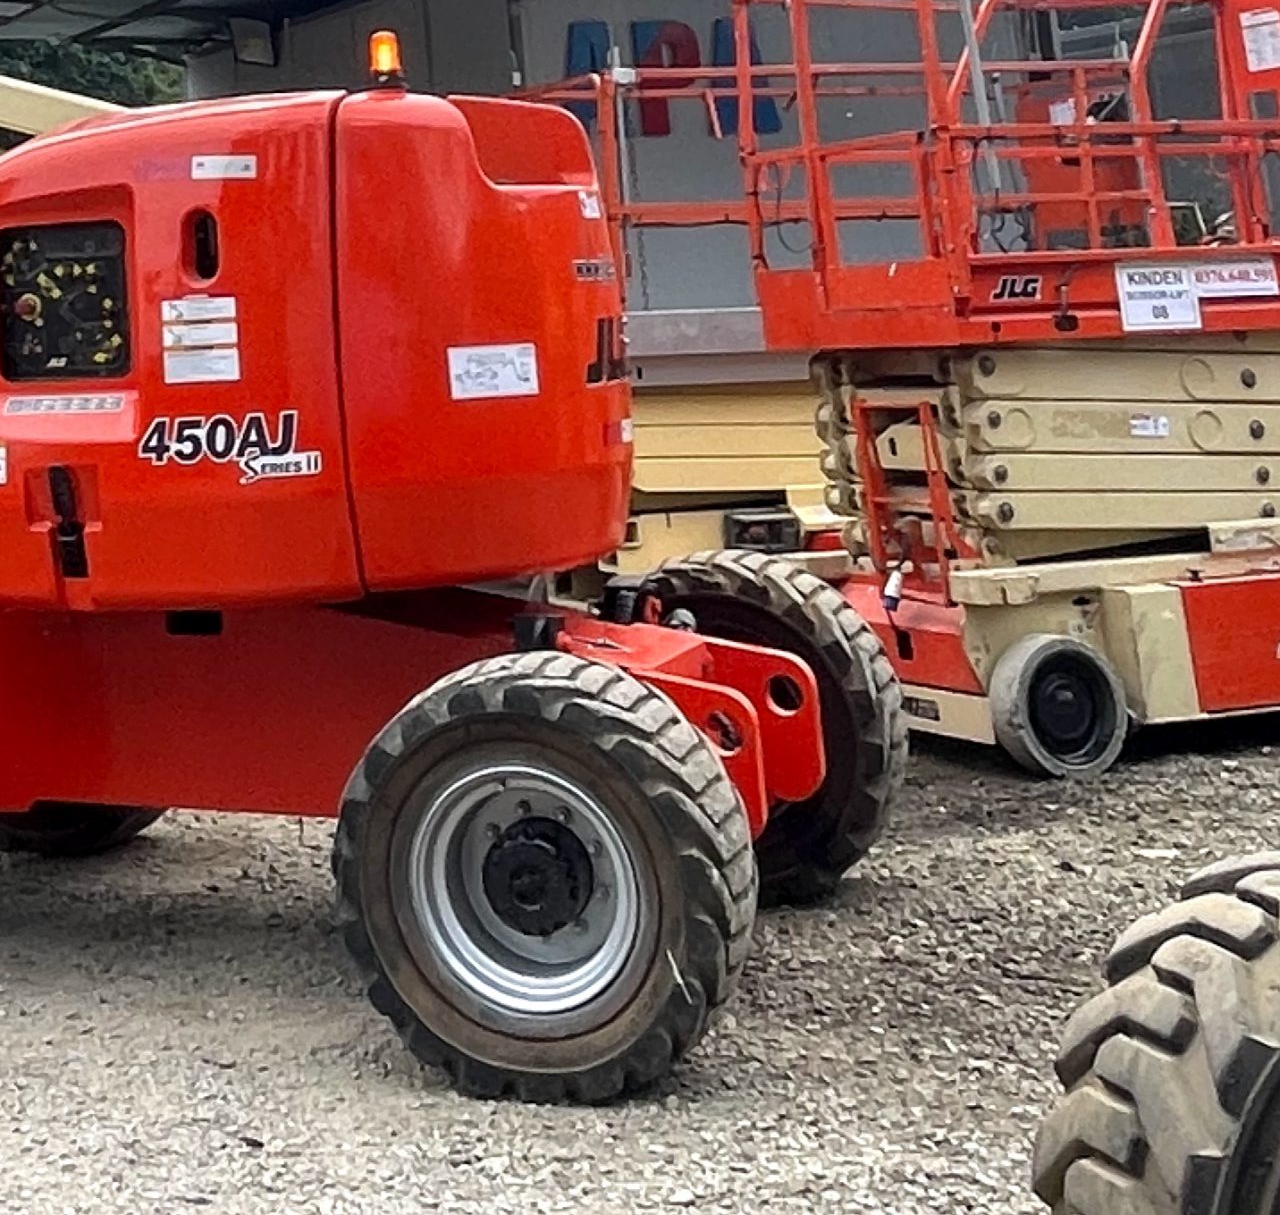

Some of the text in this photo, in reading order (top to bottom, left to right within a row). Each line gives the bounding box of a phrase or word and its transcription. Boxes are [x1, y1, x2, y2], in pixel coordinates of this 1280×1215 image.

[992, 277, 1041, 301] JLG
[1126, 269, 1184, 287] KINDEN
[140, 411, 296, 465] 450AJ
